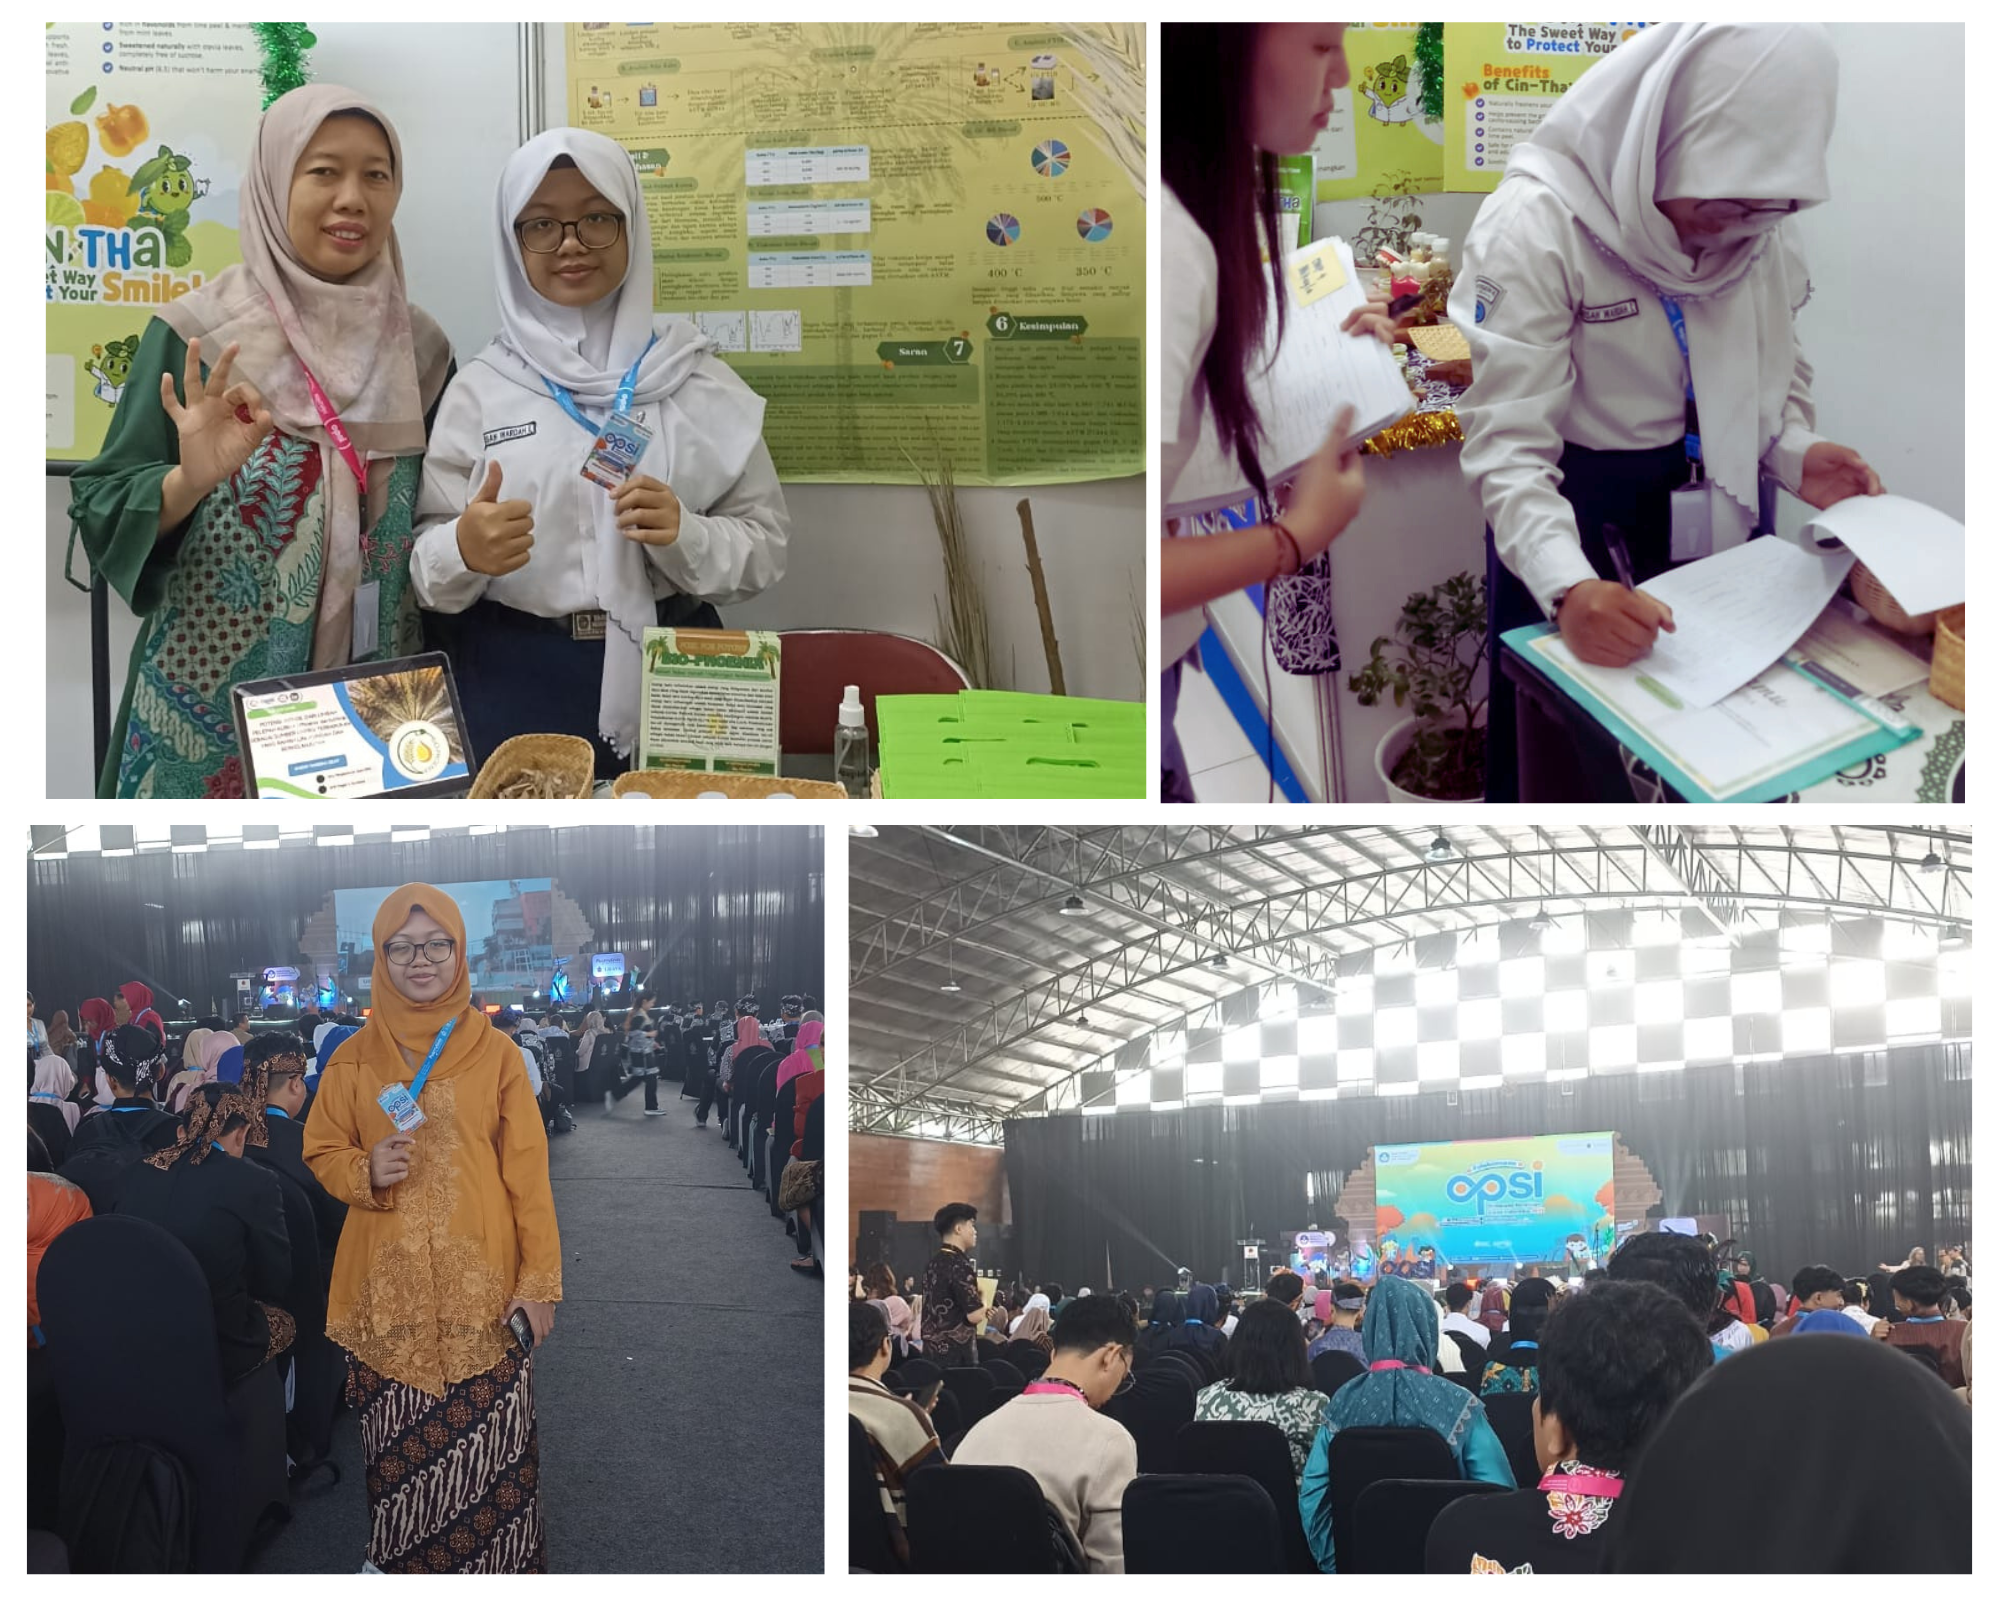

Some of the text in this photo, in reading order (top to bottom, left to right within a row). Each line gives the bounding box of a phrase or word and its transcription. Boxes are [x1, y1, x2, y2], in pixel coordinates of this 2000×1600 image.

[1508, 24, 1617, 43] The Sweet Way
[1507, 37, 1618, 54] to Protect Your
[1482, 64, 1550, 79] Benefits
[1483, 78, 1500, 91] of
[62, 270, 96, 288] Way
[987, 267, 1008, 278] 400
[1075, 266, 1097, 277] 350
[58, 286, 98, 301] Your
[996, 316, 1080, 334] 6 Kesimpulan
[898, 340, 965, 356] Saran 7
[604, 432, 641, 456] opsi
[387, 1093, 409, 1113] opsi
[1446, 1160, 1544, 1216] opsi
